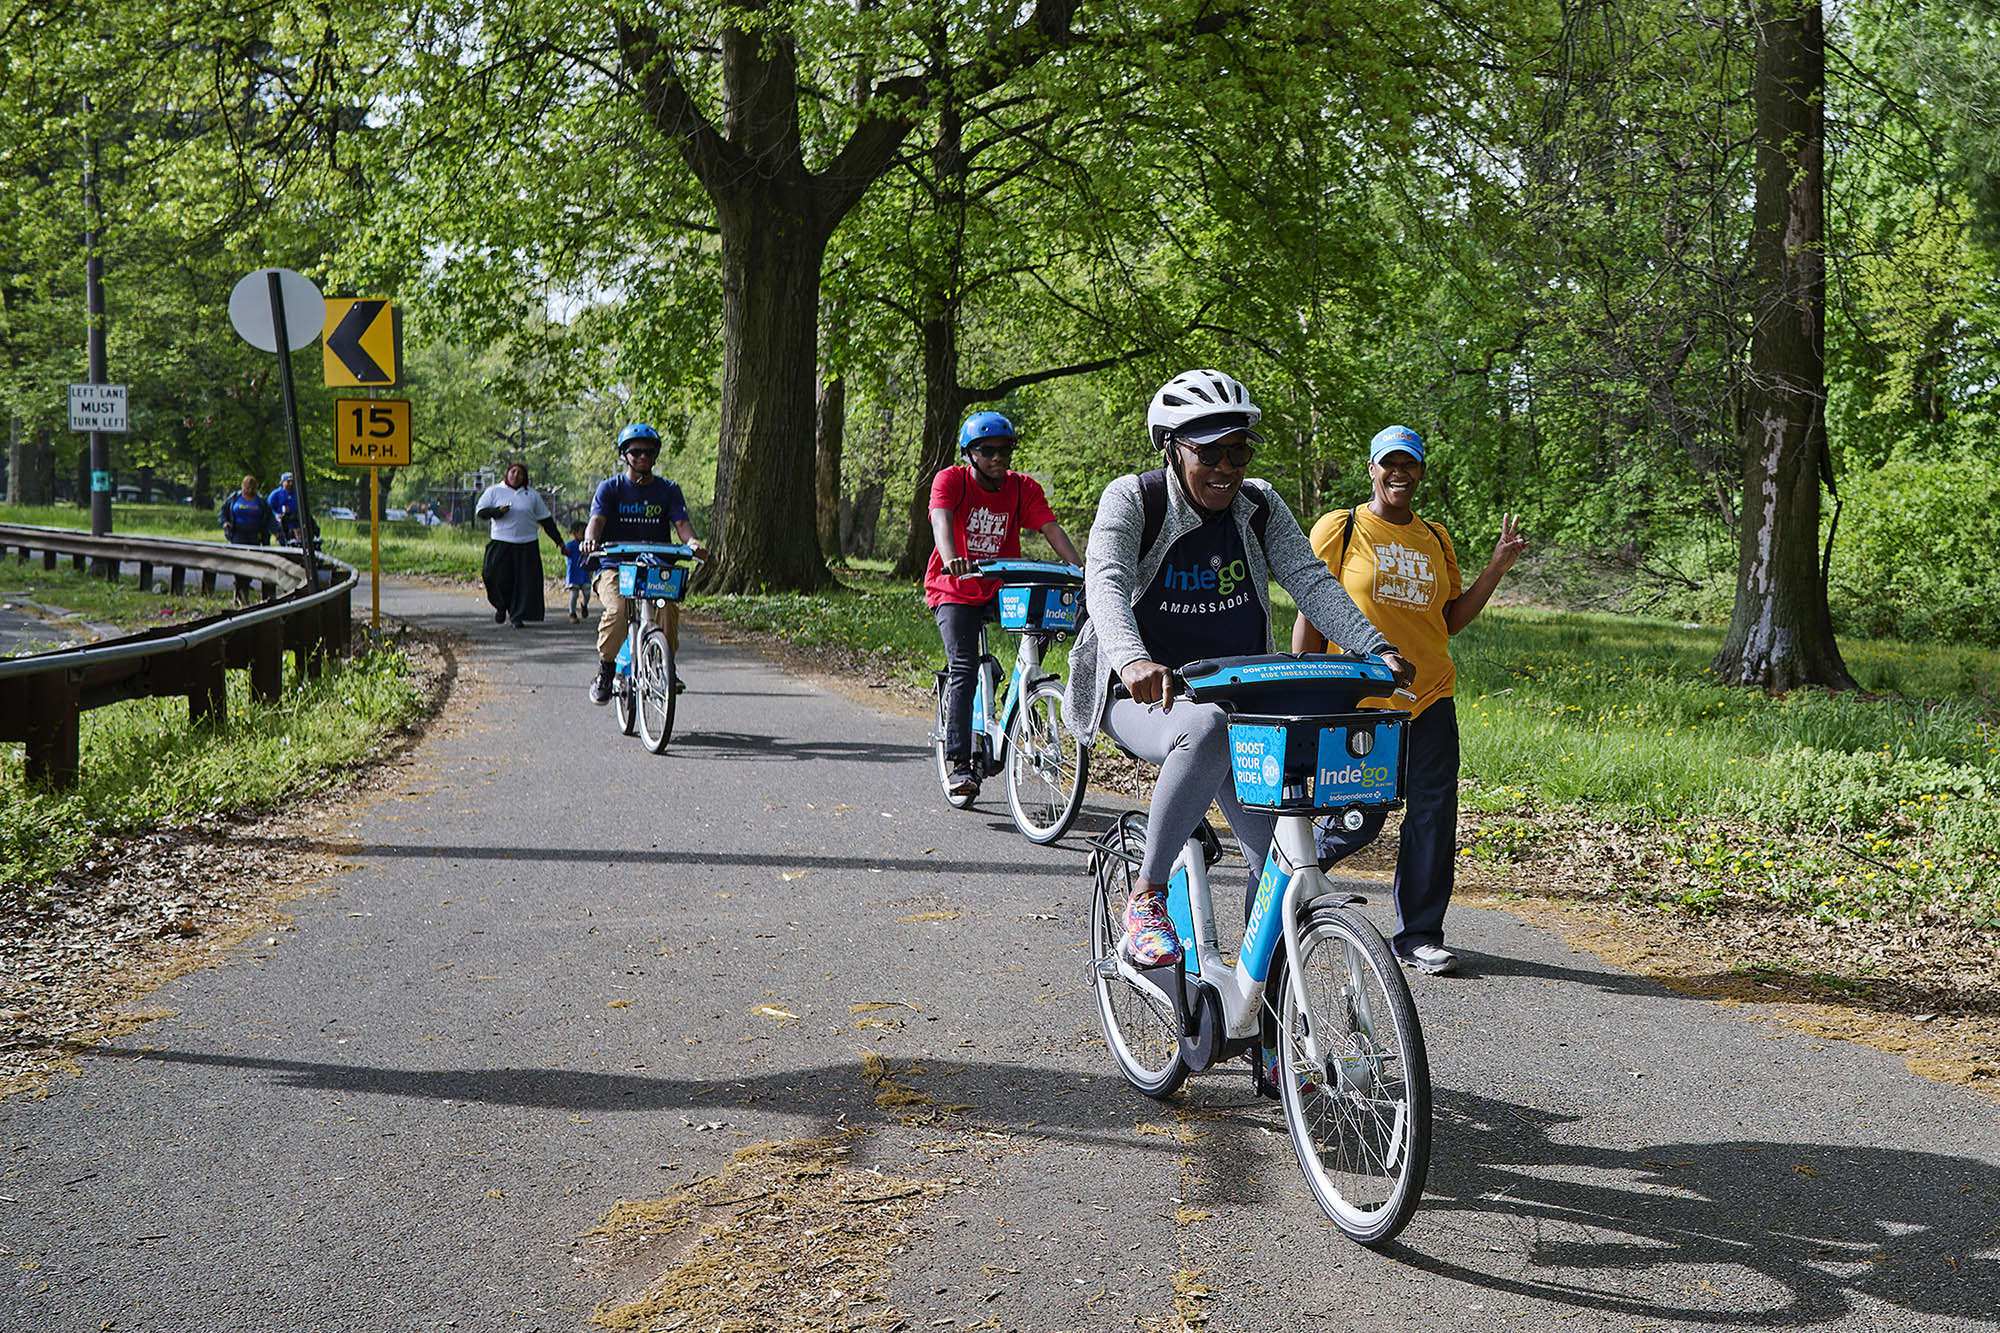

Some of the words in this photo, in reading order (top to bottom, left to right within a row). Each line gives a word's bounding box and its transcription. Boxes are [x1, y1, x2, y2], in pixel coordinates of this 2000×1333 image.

[72, 387, 93, 398] LEFT
[100, 388, 124, 399] LANE
[81, 402, 115, 413] MUST
[73, 416, 98, 426] TURN
[103, 417, 124, 427] LEFT
[352, 407, 395, 438] 15
[350, 443, 398, 457] M.P.H.
[966, 518, 1005, 536] PHL
[1376, 546, 1392, 556] WE
[1377, 554, 1433, 581] PHL
[1164, 559, 1246, 595] Indego
[1159, 592, 1249, 614] AMBASSADOR
[1236, 741, 1265, 755] BOOST
[1236, 756, 1260, 770] YOUR
[1237, 770, 1258, 784] RIDE
[1320, 765, 1388, 788] Indego
[1329, 792, 1374, 801] Independence
